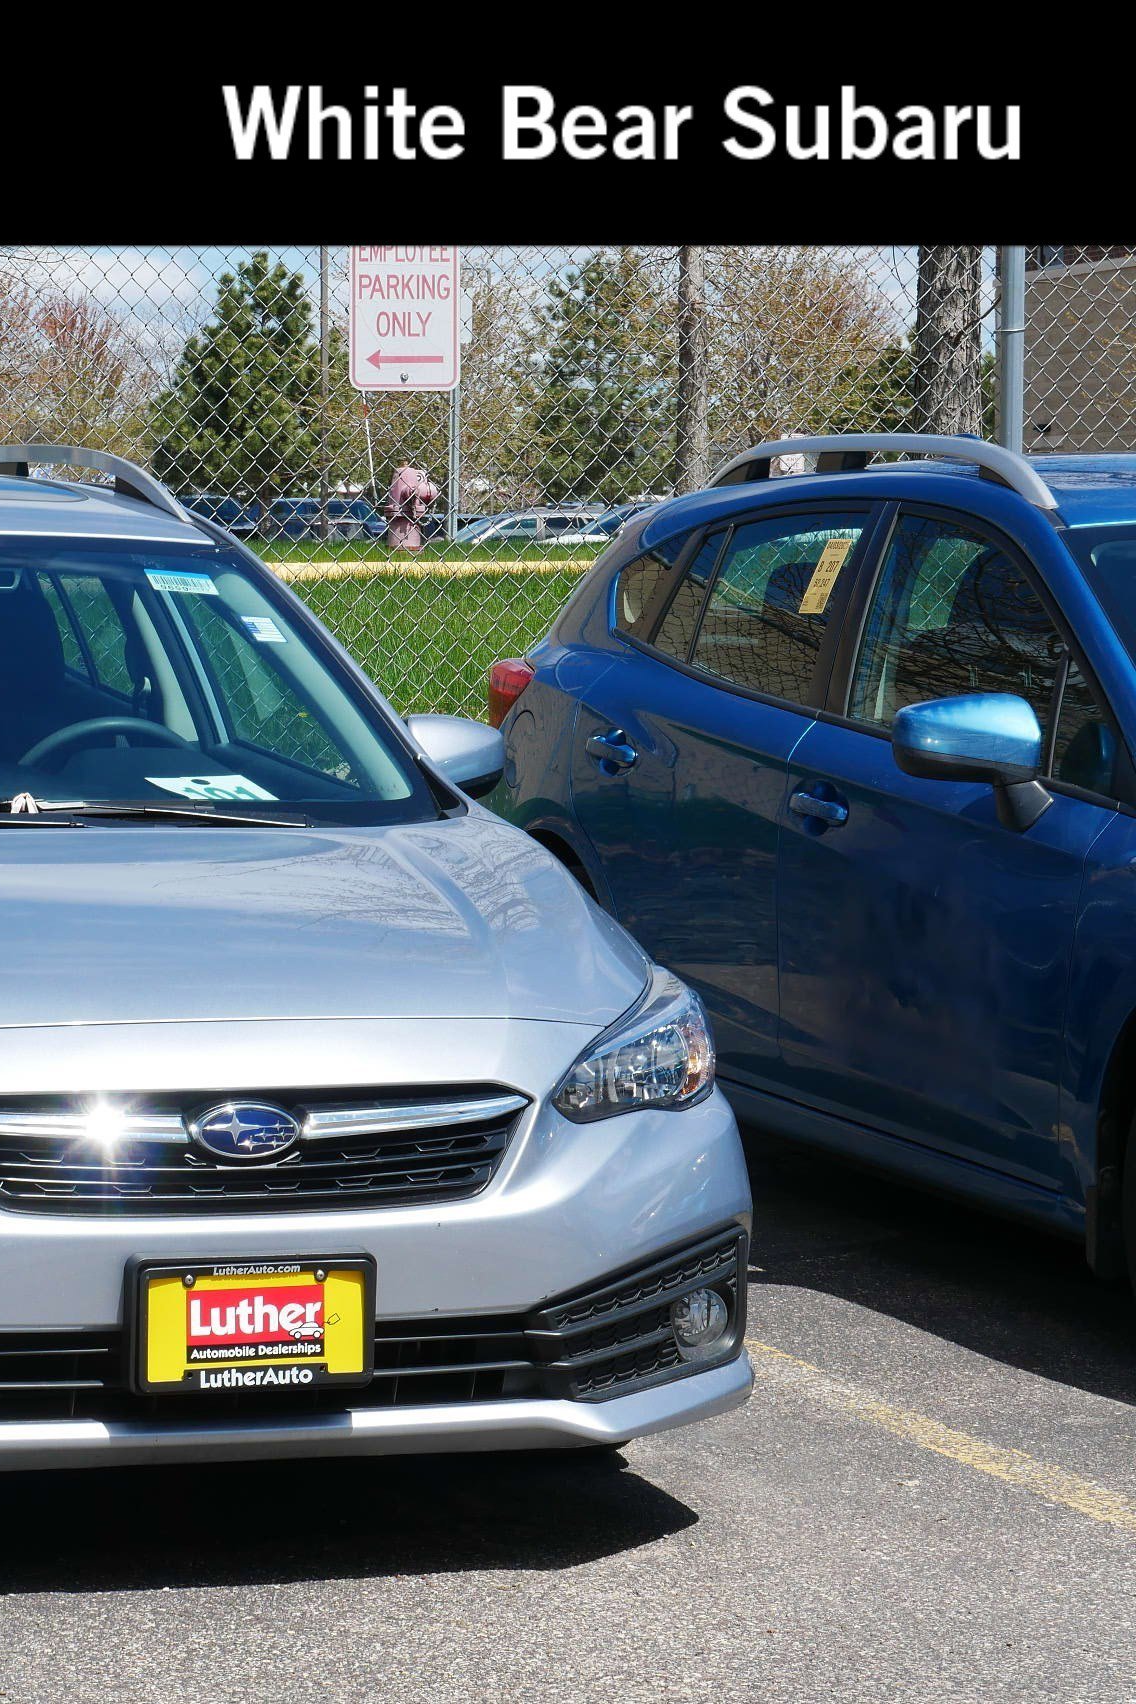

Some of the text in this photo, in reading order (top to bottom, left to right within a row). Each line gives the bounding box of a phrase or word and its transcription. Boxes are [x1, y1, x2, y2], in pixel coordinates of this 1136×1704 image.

[358, 245, 450, 263] EMPLOYEE
[358, 274, 451, 300] PARKING
[376, 311, 432, 337] ONLY
[213, 1264, 301, 1276] LutherAuto.com
[190, 1296, 322, 1337] Luther
[190, 1342, 321, 1360] Automobile Dealerships
[200, 1367, 313, 1389] LutherAuto
